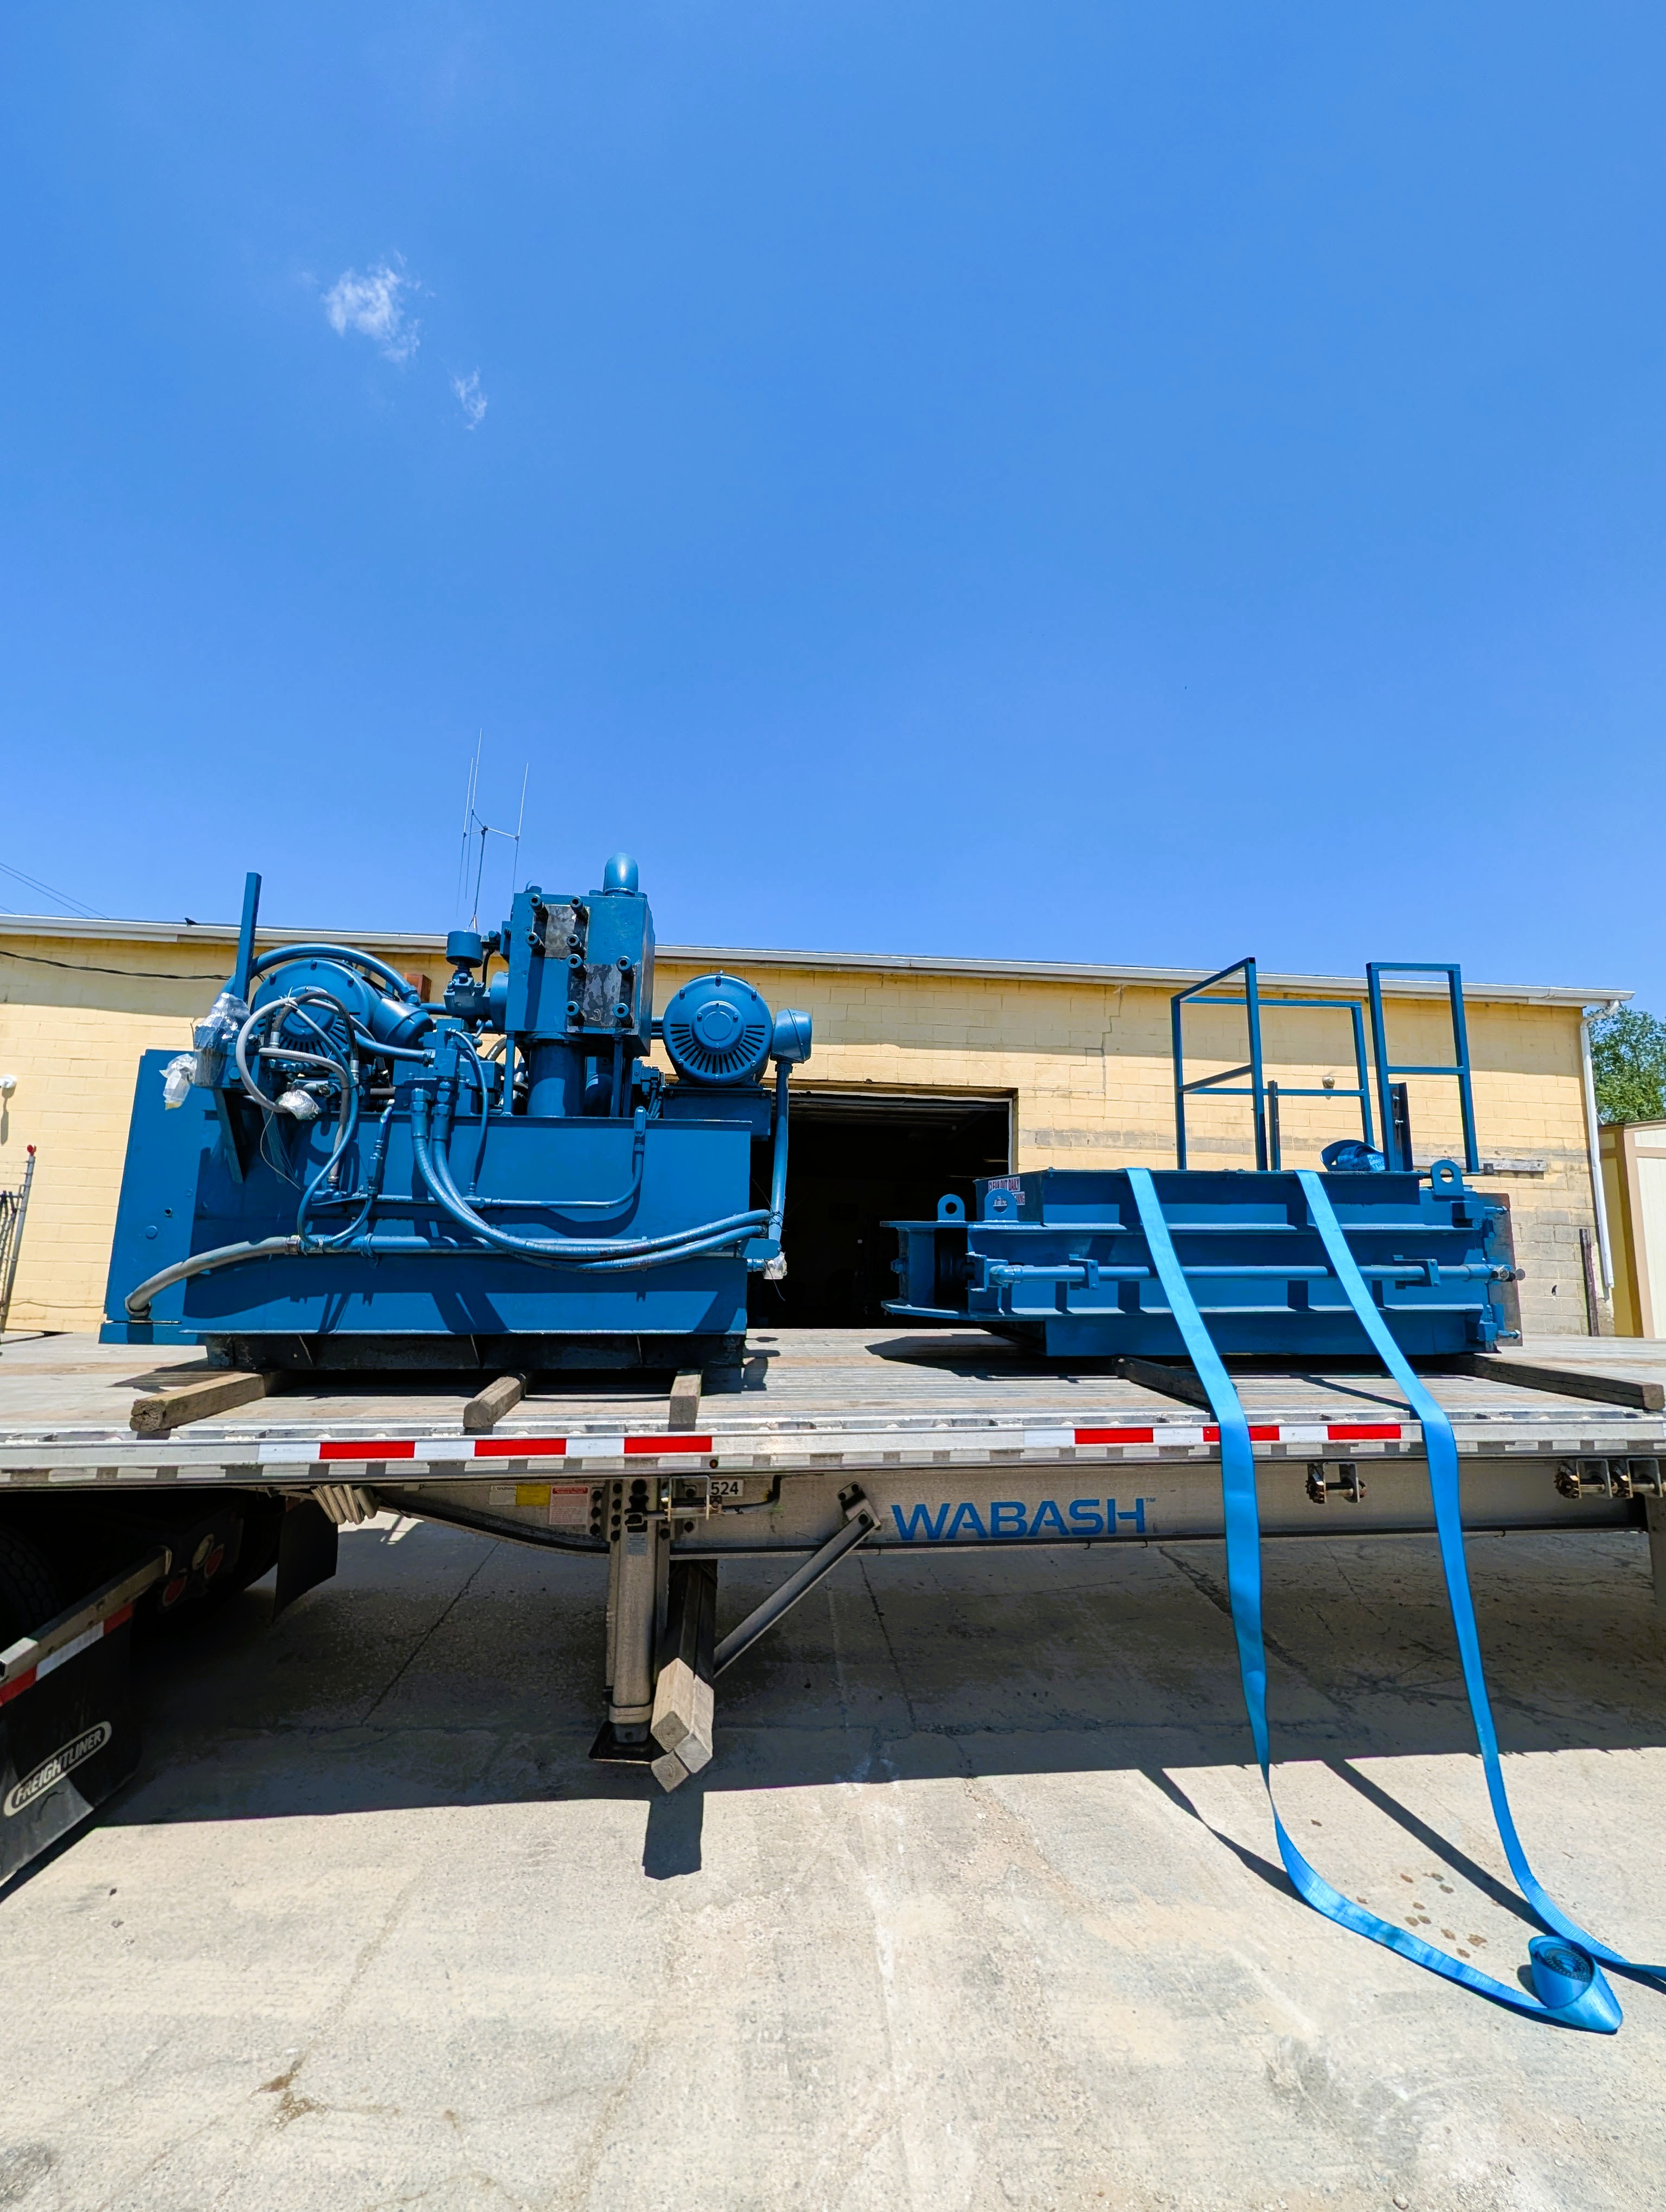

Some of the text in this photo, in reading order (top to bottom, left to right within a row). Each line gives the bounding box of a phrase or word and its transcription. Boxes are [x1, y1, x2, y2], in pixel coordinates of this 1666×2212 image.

[1009, 1178, 1020, 1191] DAILY
[710, 1481, 739, 1495] 524
[891, 1497, 1146, 1540] WABASH
[15, 1729, 102, 1805] FREIGHTLINER
